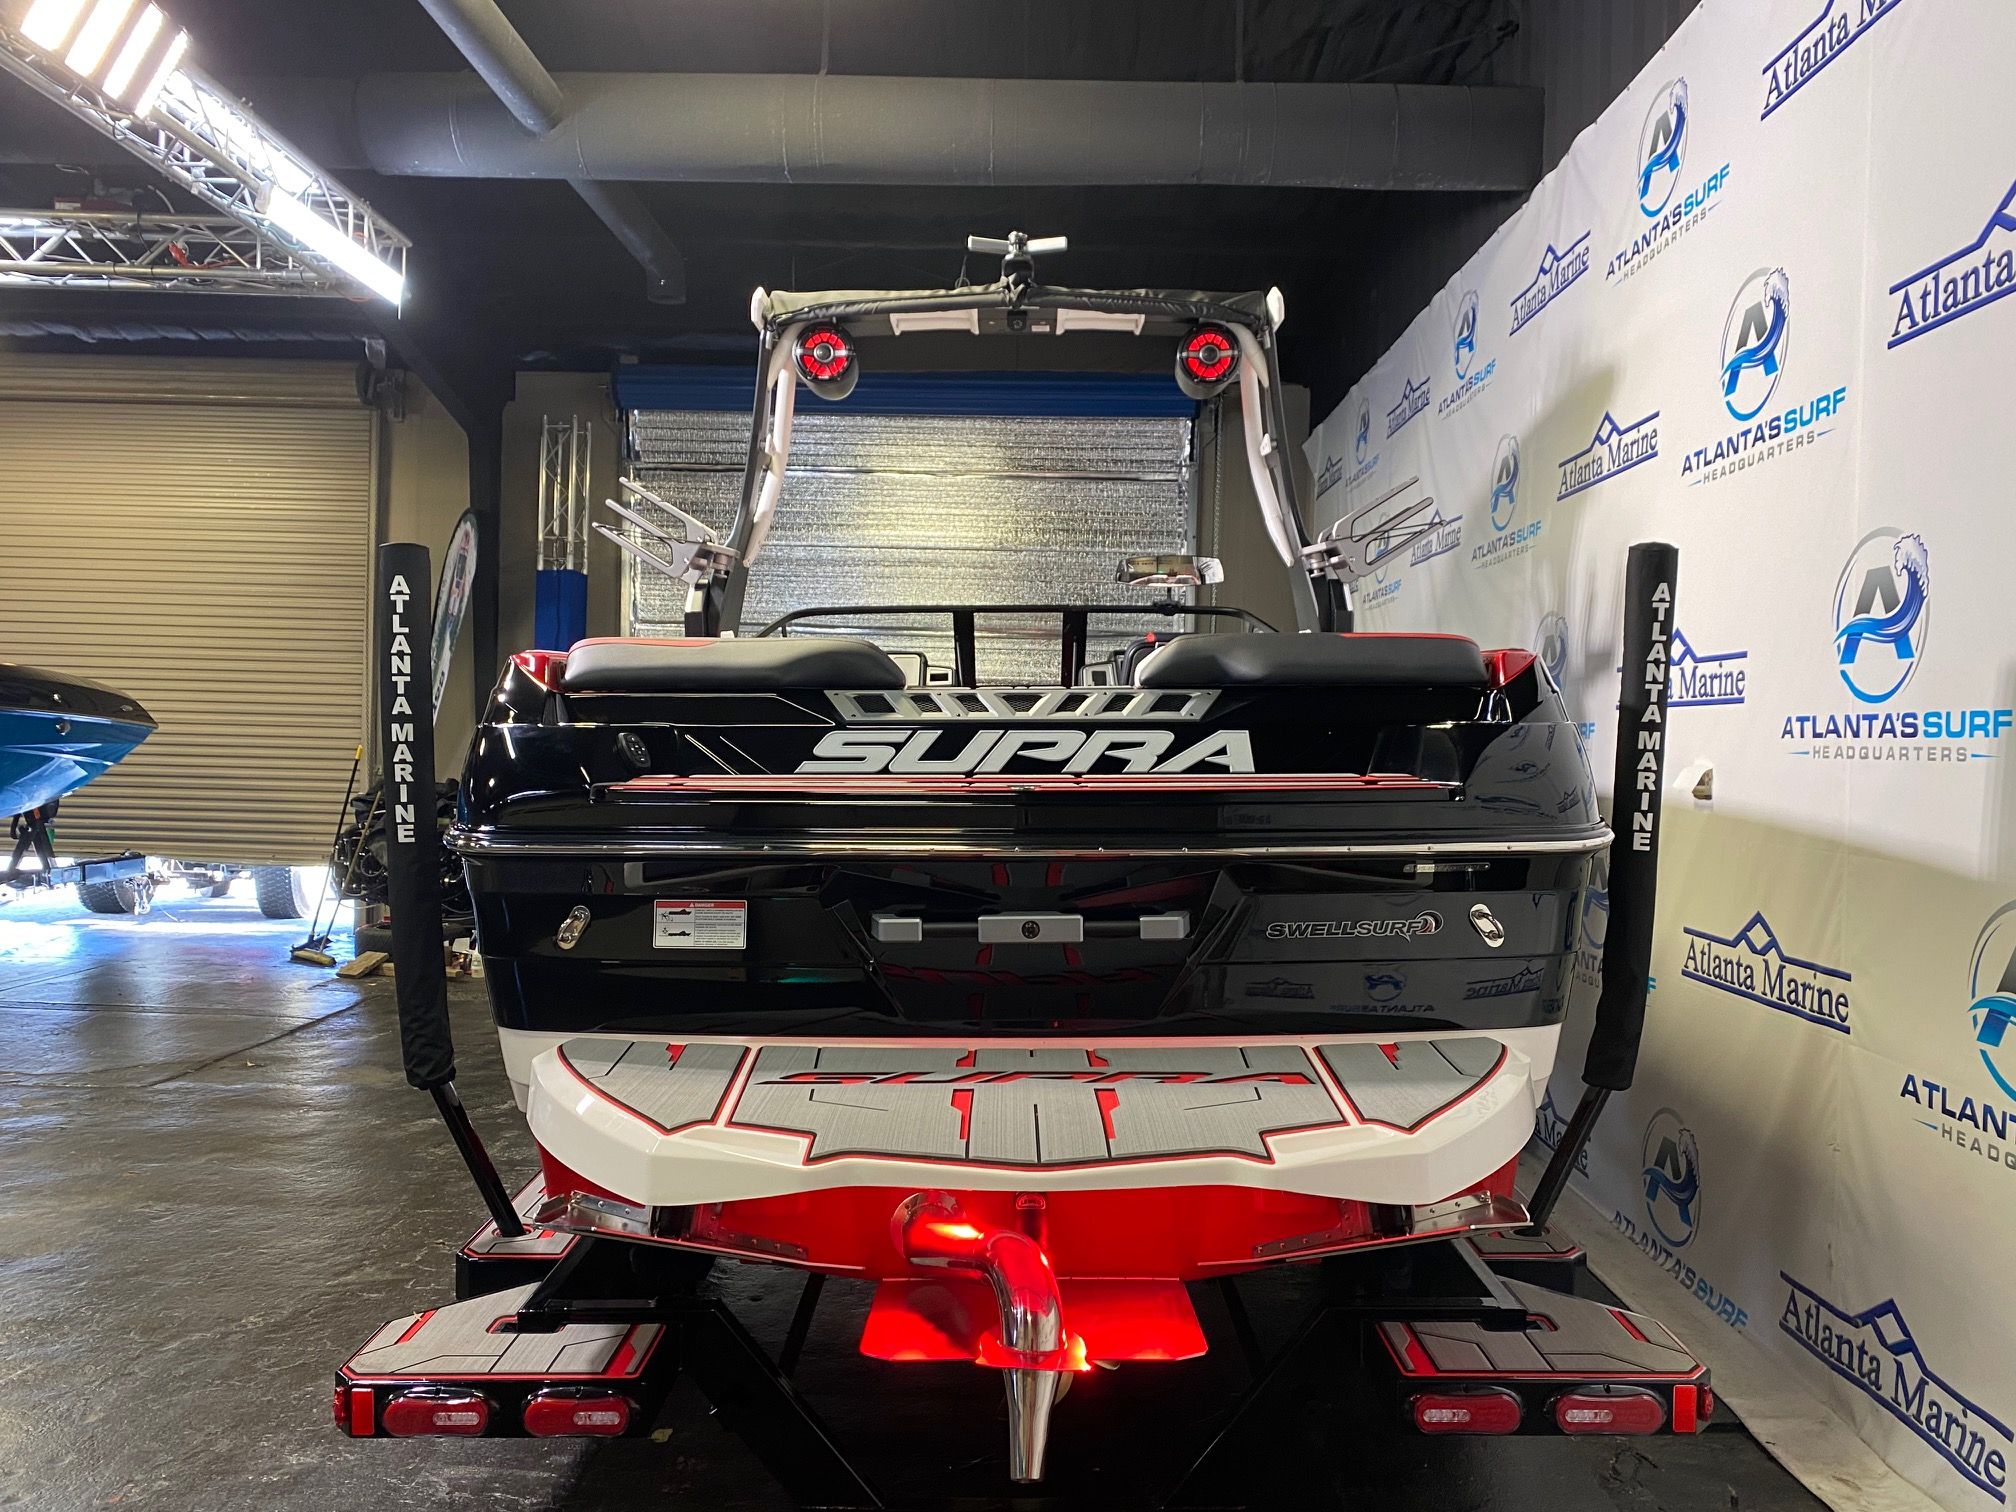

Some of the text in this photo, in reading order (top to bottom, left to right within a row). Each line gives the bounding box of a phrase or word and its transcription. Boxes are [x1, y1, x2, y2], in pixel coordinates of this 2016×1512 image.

[1763, 12, 1851, 110] Atlanta
[1622, 208, 1707, 281] HEADQUARTERS
[1511, 245, 1590, 330] Atlanta Marine
[1891, 249, 2016, 338] Atlanta
[1558, 427, 1658, 495] Atlanta Marine
[1702, 430, 1815, 485] HEADQUARTERS
[389, 574, 416, 843] ATLANTA MARINE
[1632, 582, 1671, 852] ATLANTA MARINE
[1678, 661, 1746, 700] Marine
[794, 729, 1256, 774] SUPRA
[1812, 745, 1968, 762] HEADQUARTERS
[1266, 918, 1424, 943] SWELLSURF
[1684, 936, 1849, 1024] Atlanta Marine
[754, 1071, 1317, 1085] SUPRA
[1782, 1288, 2006, 1488] Atlanta Marine
